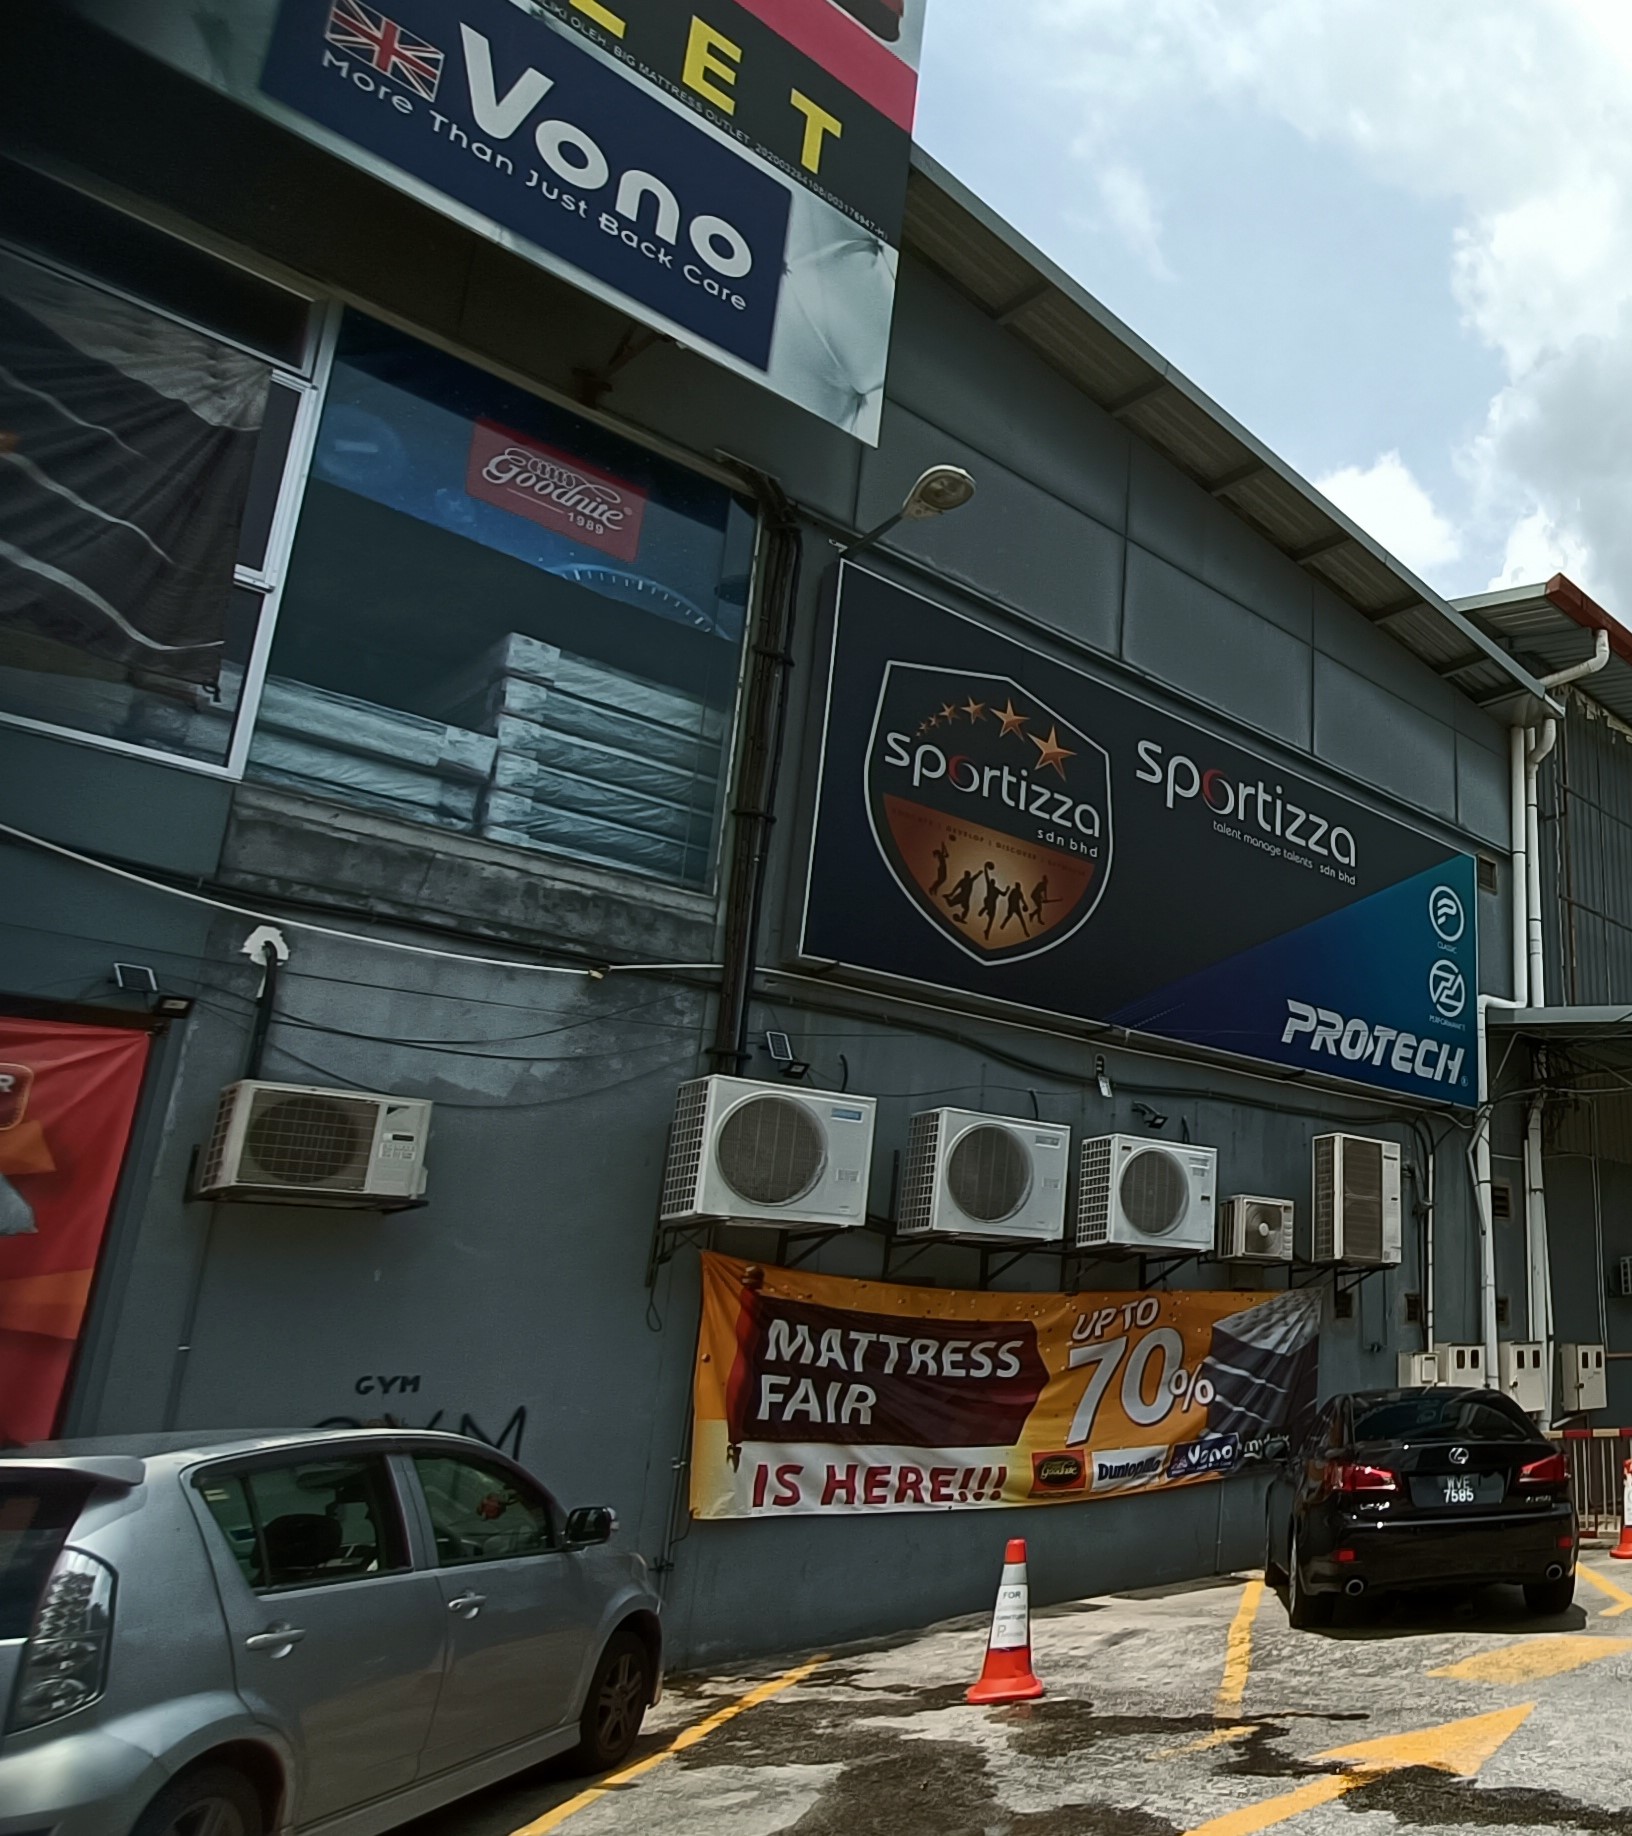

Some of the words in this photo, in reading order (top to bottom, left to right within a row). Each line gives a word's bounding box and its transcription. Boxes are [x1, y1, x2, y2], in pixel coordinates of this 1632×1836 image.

[613, 45, 636, 66] BIG
[639, 63, 703, 113] MATTRESS
[705, 109, 750, 144] OUTLET
[321, 50, 414, 115] More
[429, 109, 513, 176] Than
[525, 169, 588, 219] Just
[598, 212, 674, 269] Back
[683, 264, 747, 311] Care
[460, 21, 752, 278] Vono
[482, 447, 626, 531] Goodnite
[567, 512, 605, 535] 1989
[884, 732, 1100, 838] sportizza
[1135, 739, 1356, 867] sportizza
[1037, 828, 1065, 847] sdn
[1069, 838, 1098, 858] bhd
[1213, 820, 1242, 841] talent
[1243, 833, 1281, 856] manage
[1283, 848, 1313, 869] talents
[1319, 864, 1336, 878] sdn
[1338, 869, 1356, 885] bhd
[1281, 999, 1465, 1085] PROTECH
[764, 1319, 1024, 1378] MATTRESS
[1072, 1308, 1117, 1340] UP
[1121, 1297, 1159, 1331] TO
[355, 1375, 421, 1395] GYM
[756, 1374, 878, 1425] FAIR
[1065, 1327, 1216, 1448] 70%
[752, 1464, 804, 1508] IS
[820, 1464, 1008, 1505] HERE!!!
[1002, 1591, 1021, 1600] FOR
